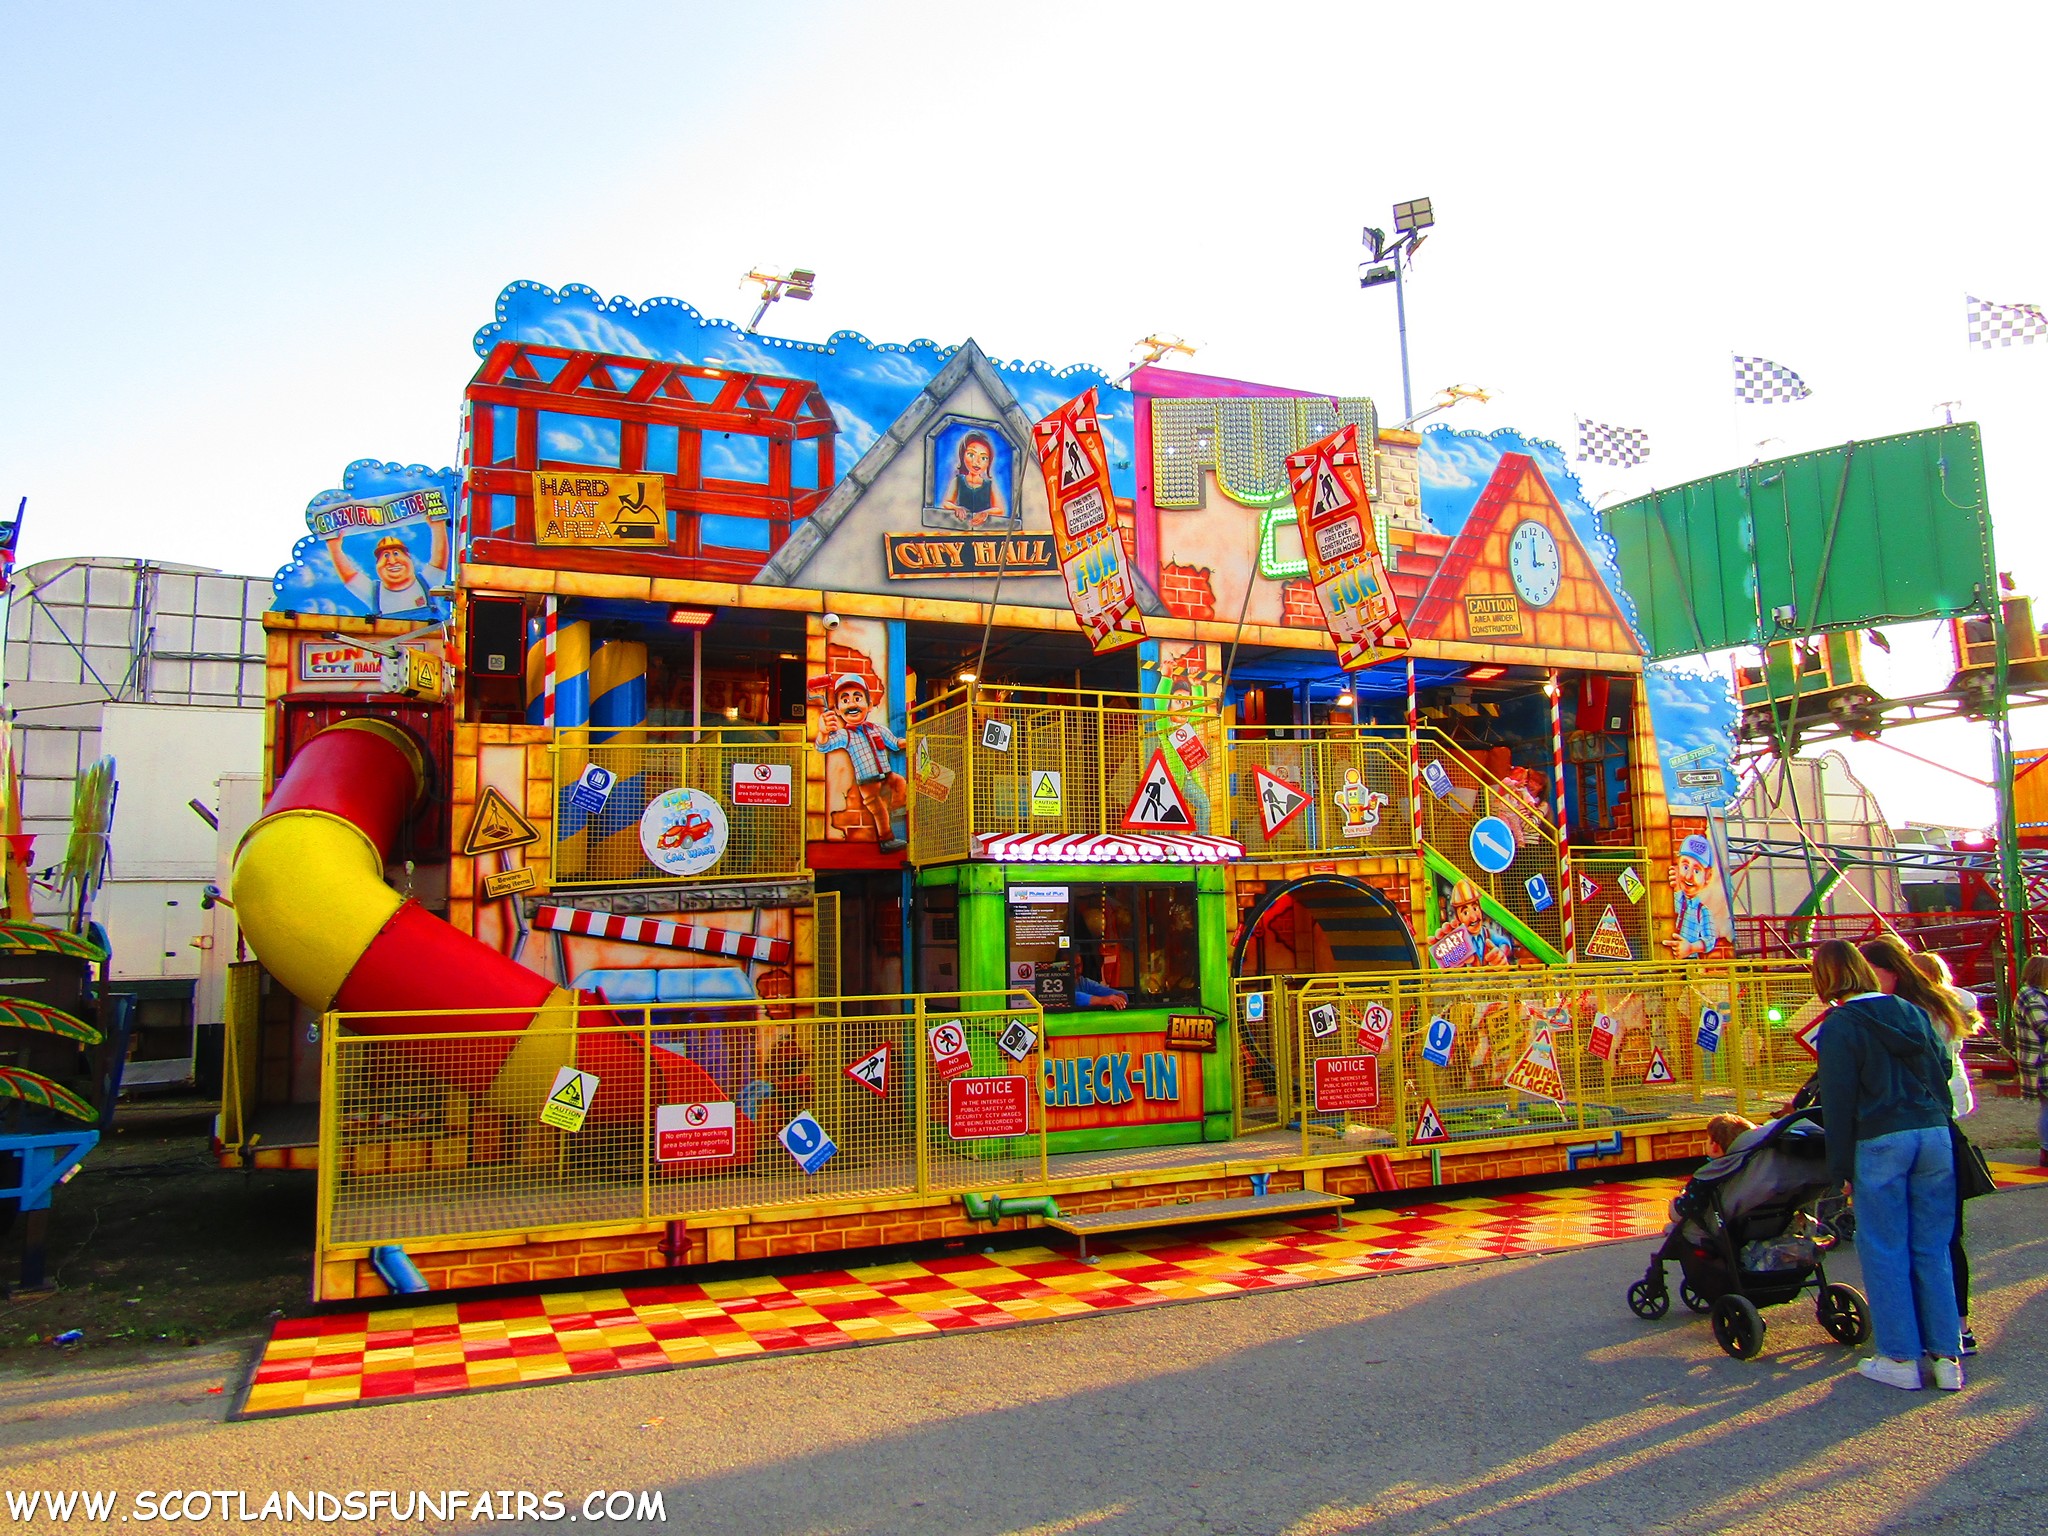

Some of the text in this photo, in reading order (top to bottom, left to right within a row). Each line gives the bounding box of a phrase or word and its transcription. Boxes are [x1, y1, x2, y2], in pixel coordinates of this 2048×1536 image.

[539, 477, 610, 498] HARD
[425, 491, 441, 500] FOR
[428, 500, 442, 508] ALL
[553, 499, 600, 519] HAT
[1072, 500, 1096, 517] FIRST EVER
[316, 494, 426, 534] CRAZY FUN INSIDE
[427, 507, 448, 516] AGES
[1069, 506, 1103, 526] CONSTRUCTION
[543, 519, 612, 540] AREA
[1070, 524, 1080, 534] SITE
[1090, 513, 1104, 526] HOUSE
[1325, 521, 1348, 536] THE UK'S
[1324, 528, 1352, 543] FIRST EVER
[1521, 530, 1527, 539] 11
[1529, 527, 1537, 536] 12
[1541, 531, 1545, 539] 1
[1320, 533, 1360, 553] CONSTRUCTION
[1321, 550, 1333, 560] SITE
[1343, 539, 1361, 553] HOUSE
[1514, 541, 1522, 550] 10
[1548, 544, 1553, 553] 2
[895, 540, 1052, 569] CITY HALL
[1073, 536, 1119, 596] FUN
[1513, 558, 1519, 566] 9
[1552, 561, 1557, 569] 3
[1516, 574, 1522, 583] 8
[1549, 578, 1555, 587] 4
[1326, 561, 1381, 616] FUN
[1525, 587, 1530, 596] 7
[1543, 587, 1548, 595] 5
[1534, 593, 1540, 601] 6
[1469, 599, 1515, 613] CAUTION
[1474, 614, 1514, 623] AREA UNDER
[1471, 624, 1519, 634] CONSTRUCTION
[311, 647, 365, 666] FUN
[311, 662, 381, 674] CITY MANA
[1671, 747, 1715, 766] MAIN STREET
[686, 845, 716, 859] WASH
[491, 879, 531, 892] falling items
[497, 874, 522, 883] Beware
[1596, 929, 1623, 939] BARRELS
[1435, 931, 1465, 958] CRAZY
[1611, 938, 1627, 947] FOR
[1443, 944, 1467, 967] FUN
[1588, 943, 1631, 958] EVERYONE
[1042, 979, 1064, 993] £3
[1171, 1017, 1214, 1039] ENTER
[1358, 1038, 1380, 1052] running
[1366, 1034, 1376, 1042] NO
[948, 1057, 959, 1065] NO
[1327, 1060, 1365, 1073] NOTICE
[942, 1062, 970, 1076] running
[1520, 1059, 1560, 1083] FUN FOR
[1036, 1052, 1179, 1108] CHECK-IN
[1507, 1073, 1564, 1101] ALL AGES
[966, 1081, 1013, 1095] NOTICE
[549, 1104, 581, 1118] CAUTION
[675, 1132, 693, 1140] entry
[700, 1139, 730, 1147] reporting
